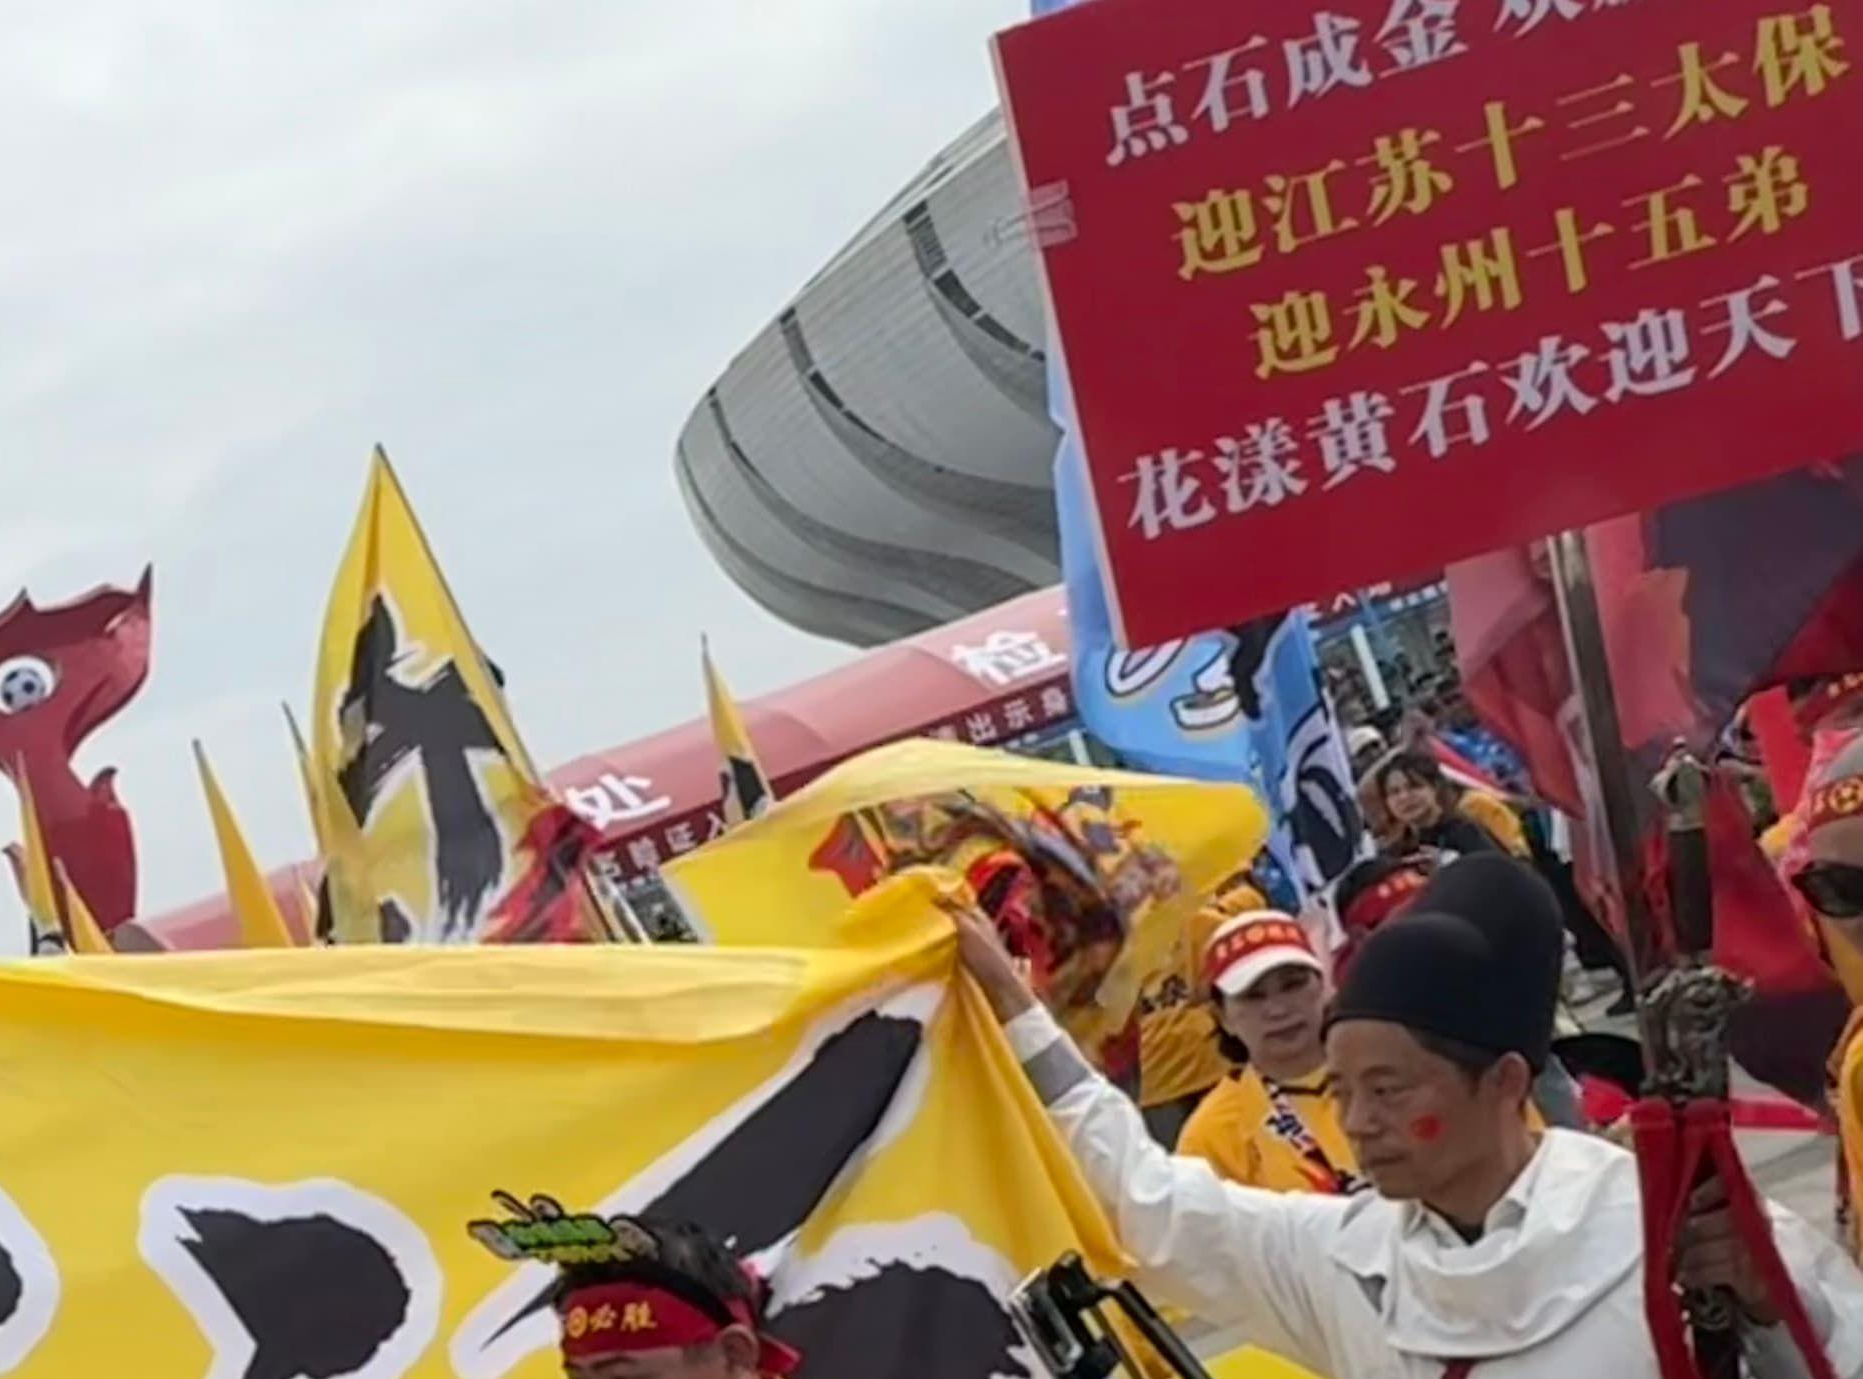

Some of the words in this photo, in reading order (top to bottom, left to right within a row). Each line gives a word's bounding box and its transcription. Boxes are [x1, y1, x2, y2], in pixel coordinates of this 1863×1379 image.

[1105, 0, 1469, 166] 点石成金
[1170, 3, 1851, 282] 迎江苏十三太保
[1248, 145, 1810, 381] 迎永州十五弟
[1116, 256, 1863, 542] 花漾黄石欢迎天下
